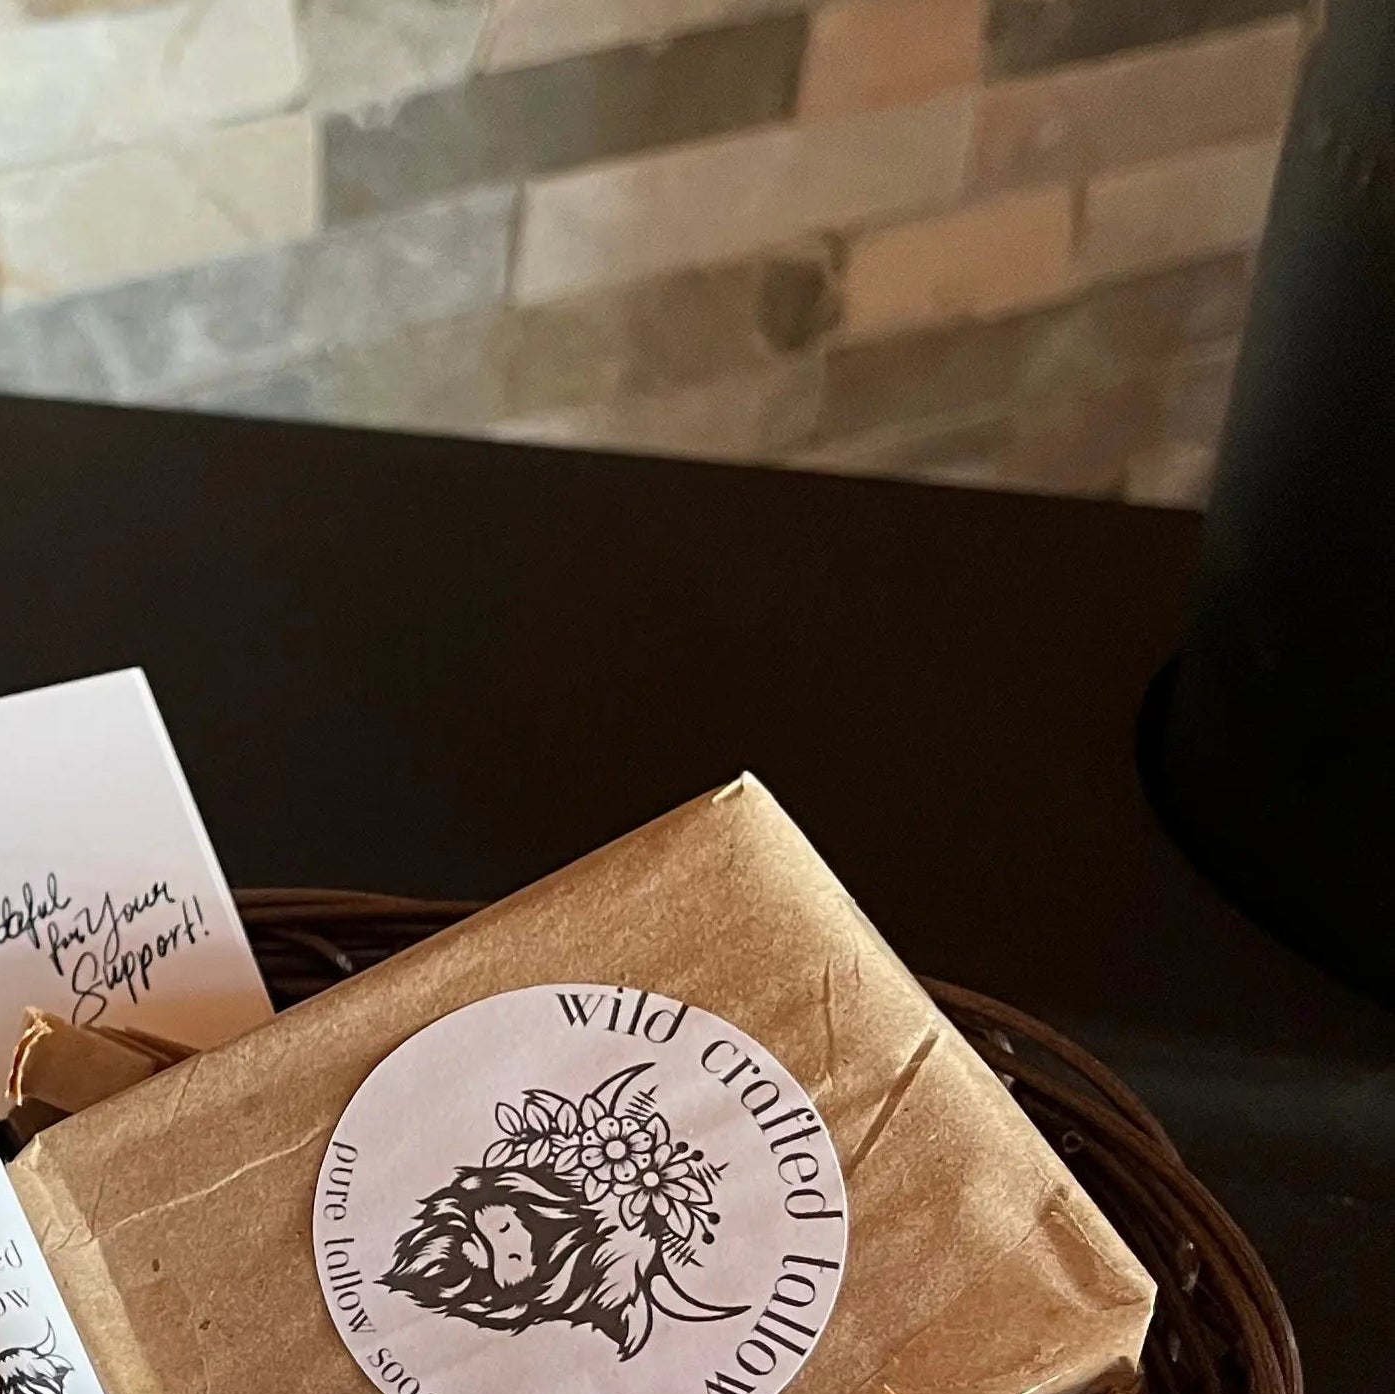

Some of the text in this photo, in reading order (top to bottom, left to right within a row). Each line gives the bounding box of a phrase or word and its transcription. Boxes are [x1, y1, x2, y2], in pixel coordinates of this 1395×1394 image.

[47, 881, 175, 976] for Your
[71, 894, 211, 1028] Support!
[554, 986, 690, 1044] wild
[699, 1039, 845, 1223] crafted
[321, 1140, 359, 1223] pure
[323, 1235, 378, 1338] tallow
